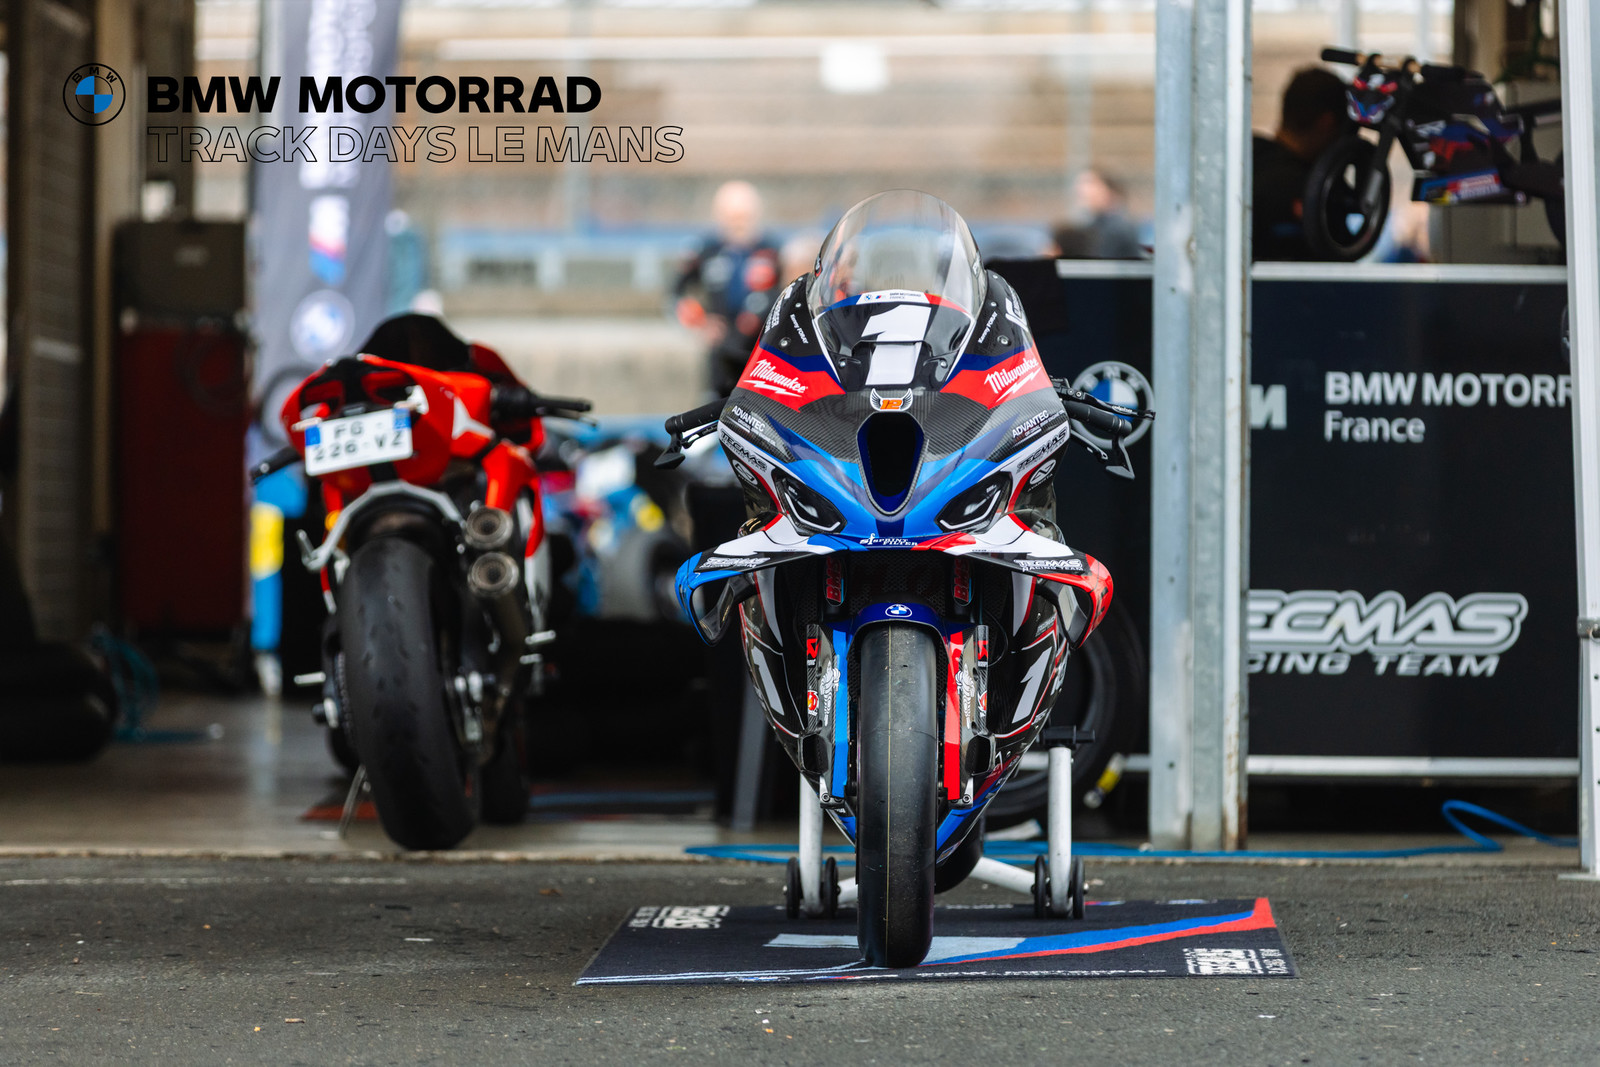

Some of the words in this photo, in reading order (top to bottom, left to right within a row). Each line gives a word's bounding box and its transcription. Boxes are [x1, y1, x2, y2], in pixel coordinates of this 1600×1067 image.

[861, 304, 931, 385] 1
[749, 359, 808, 394] Milwaukee
[984, 357, 1039, 394] Milwaukee
[1325, 371, 1417, 406] BMW
[1422, 372, 1572, 407] MOTORR
[731, 405, 766, 432] ADVANTEC
[880, 399, 903, 410] 12
[1012, 410, 1049, 438] ADVANTEC
[1324, 410, 1426, 443] France
[1247, 590, 1528, 655] ECMAS
[1373, 654, 1501, 677] TEAM
[1012, 646, 1053, 724] 1
